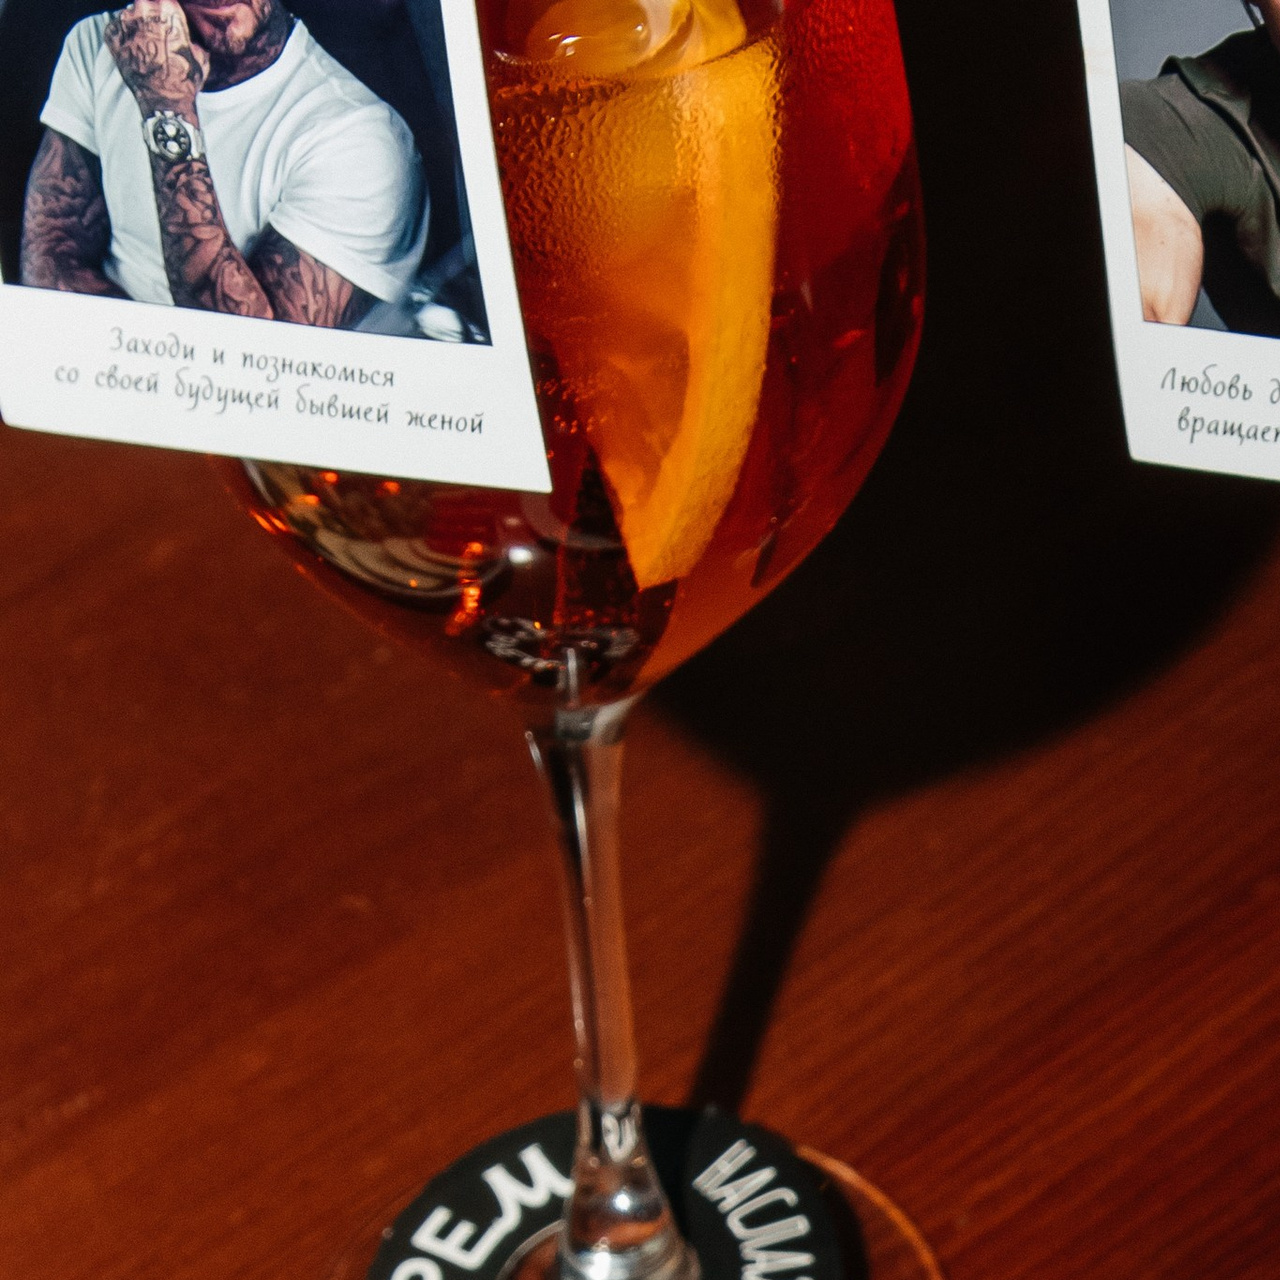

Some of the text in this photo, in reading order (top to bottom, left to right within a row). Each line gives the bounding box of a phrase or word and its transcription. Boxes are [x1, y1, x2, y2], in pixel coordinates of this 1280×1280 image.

[110, 326, 396, 388] Заходи и познакомься
[1160, 365, 1253, 401] Любовь
[55, 363, 484, 435] со своей будущей бывшей женой
